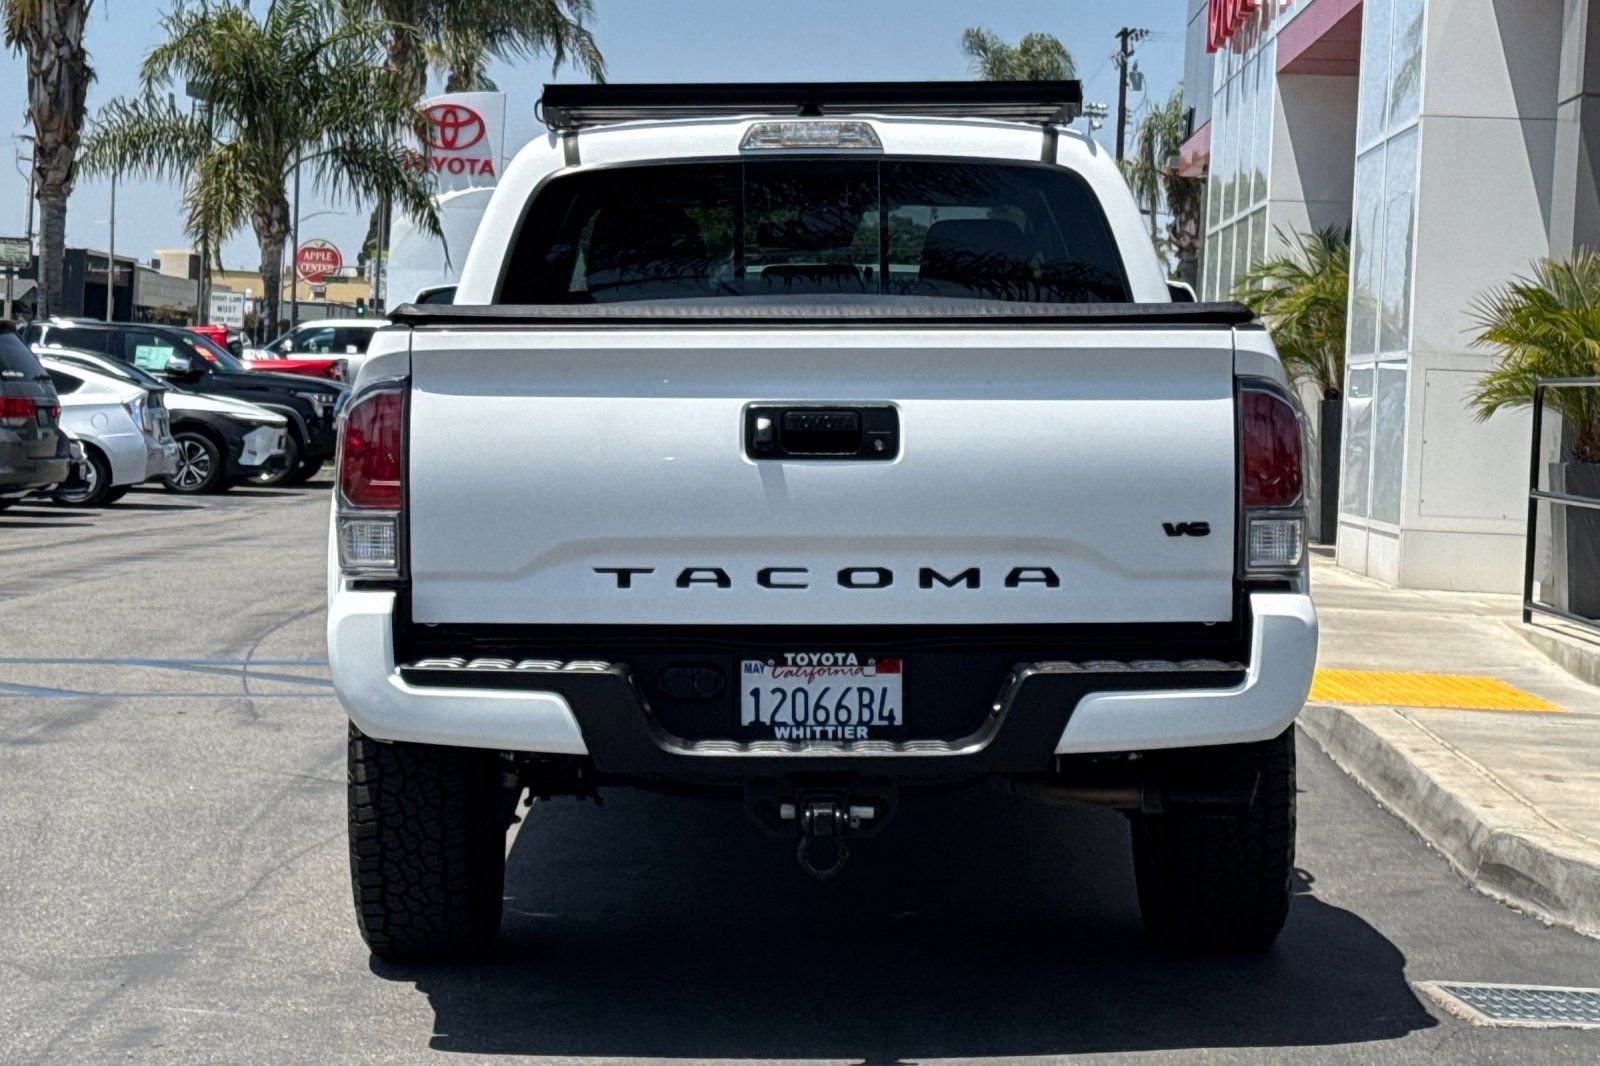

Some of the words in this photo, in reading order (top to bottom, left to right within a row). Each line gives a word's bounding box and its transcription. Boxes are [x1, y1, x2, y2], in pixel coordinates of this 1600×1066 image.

[400, 155, 496, 177] YOTA
[303, 250, 333, 262] APPLE
[300, 262, 335, 274] CENTER
[217, 305, 236, 314] MUST
[1161, 521, 1211, 537] V6
[592, 567, 1061, 589] TACOMA
[783, 652, 859, 666] TOYOTA
[744, 662, 765, 675] MAY
[769, 665, 877, 685] California
[749, 686, 897, 726] 12066B4
[774, 725, 869, 740] WHITTIER
